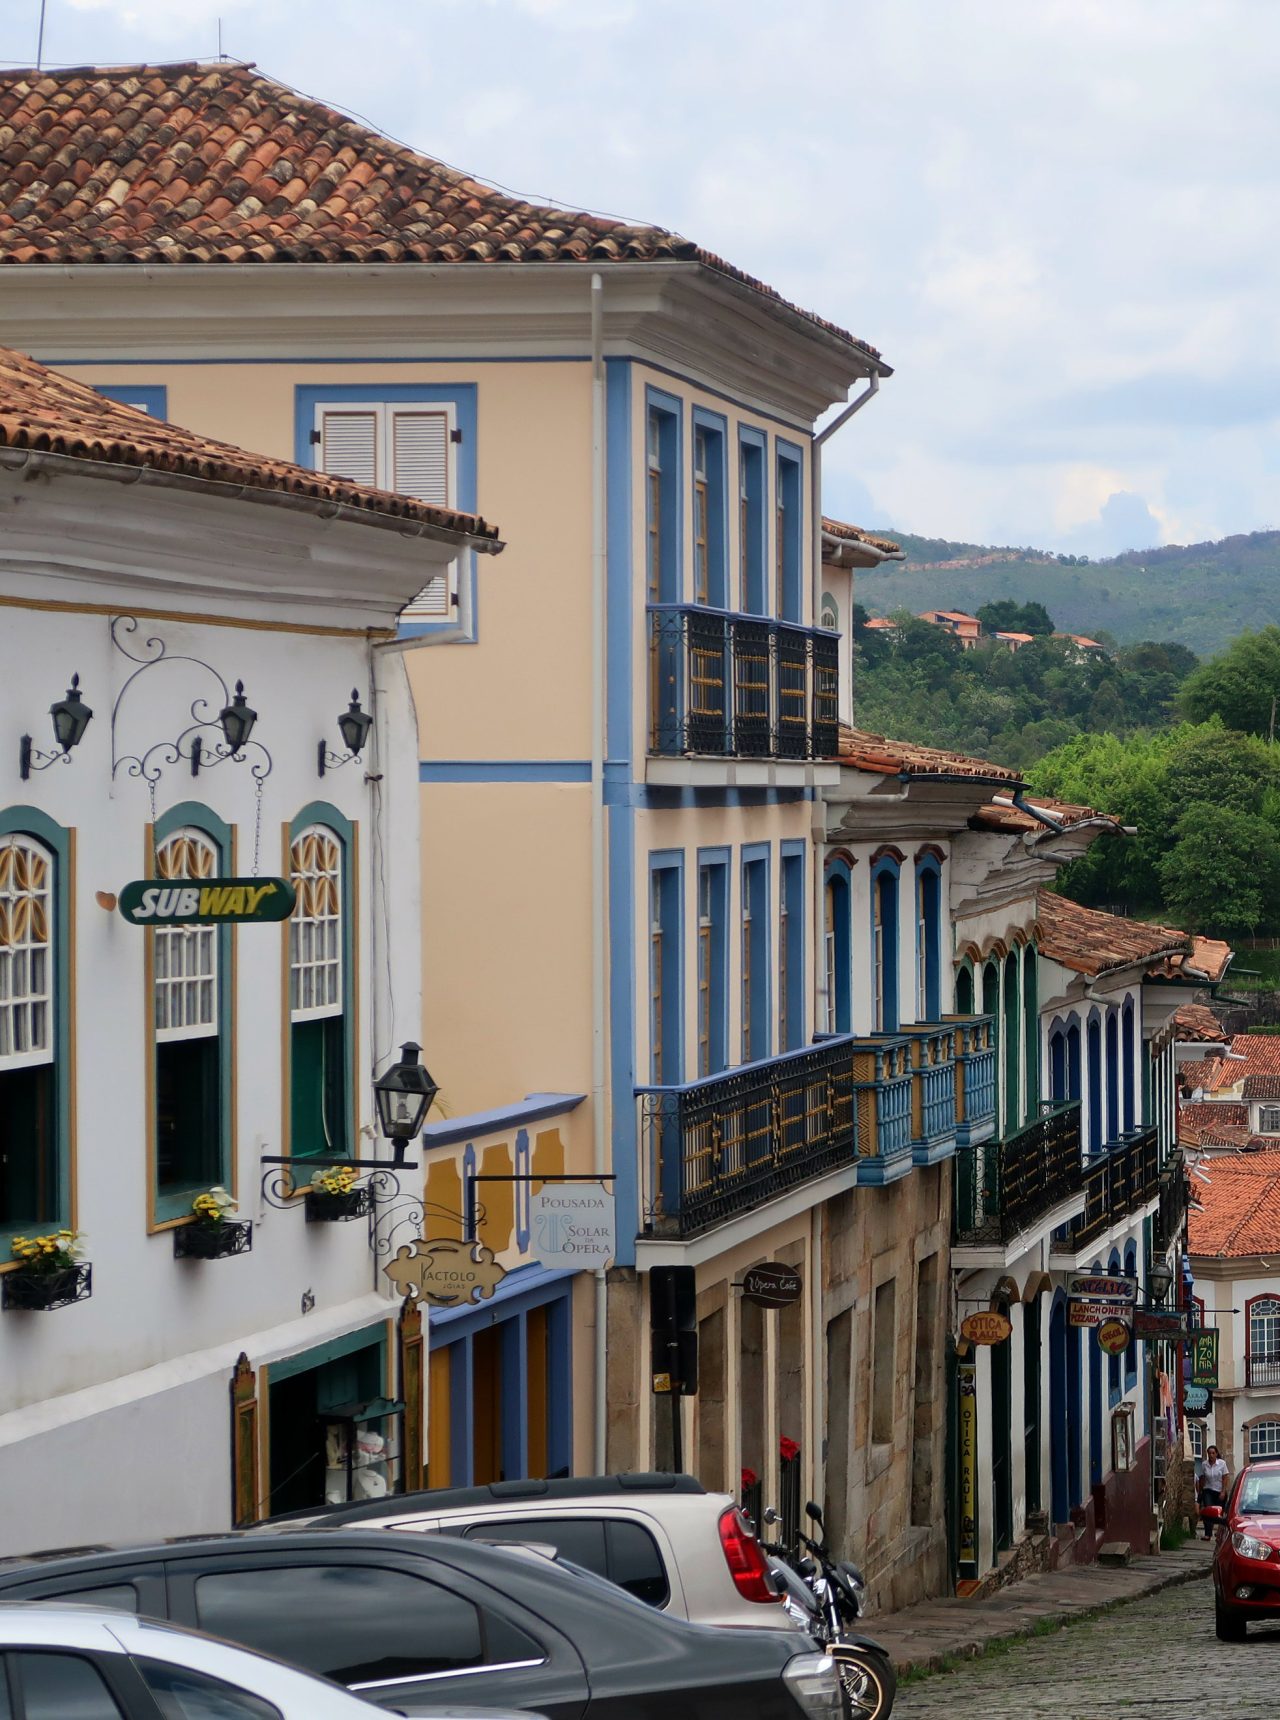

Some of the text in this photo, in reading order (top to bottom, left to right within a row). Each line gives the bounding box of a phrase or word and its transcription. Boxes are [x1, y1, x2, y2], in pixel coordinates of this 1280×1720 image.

[131, 882, 278, 920] SUBWAY
[541, 1196, 605, 1208] POUSADA
[568, 1225, 610, 1237] SOLAR
[562, 1238, 611, 1254] ÓPERA
[1073, 1304, 1131, 1316] LANCHONETE
